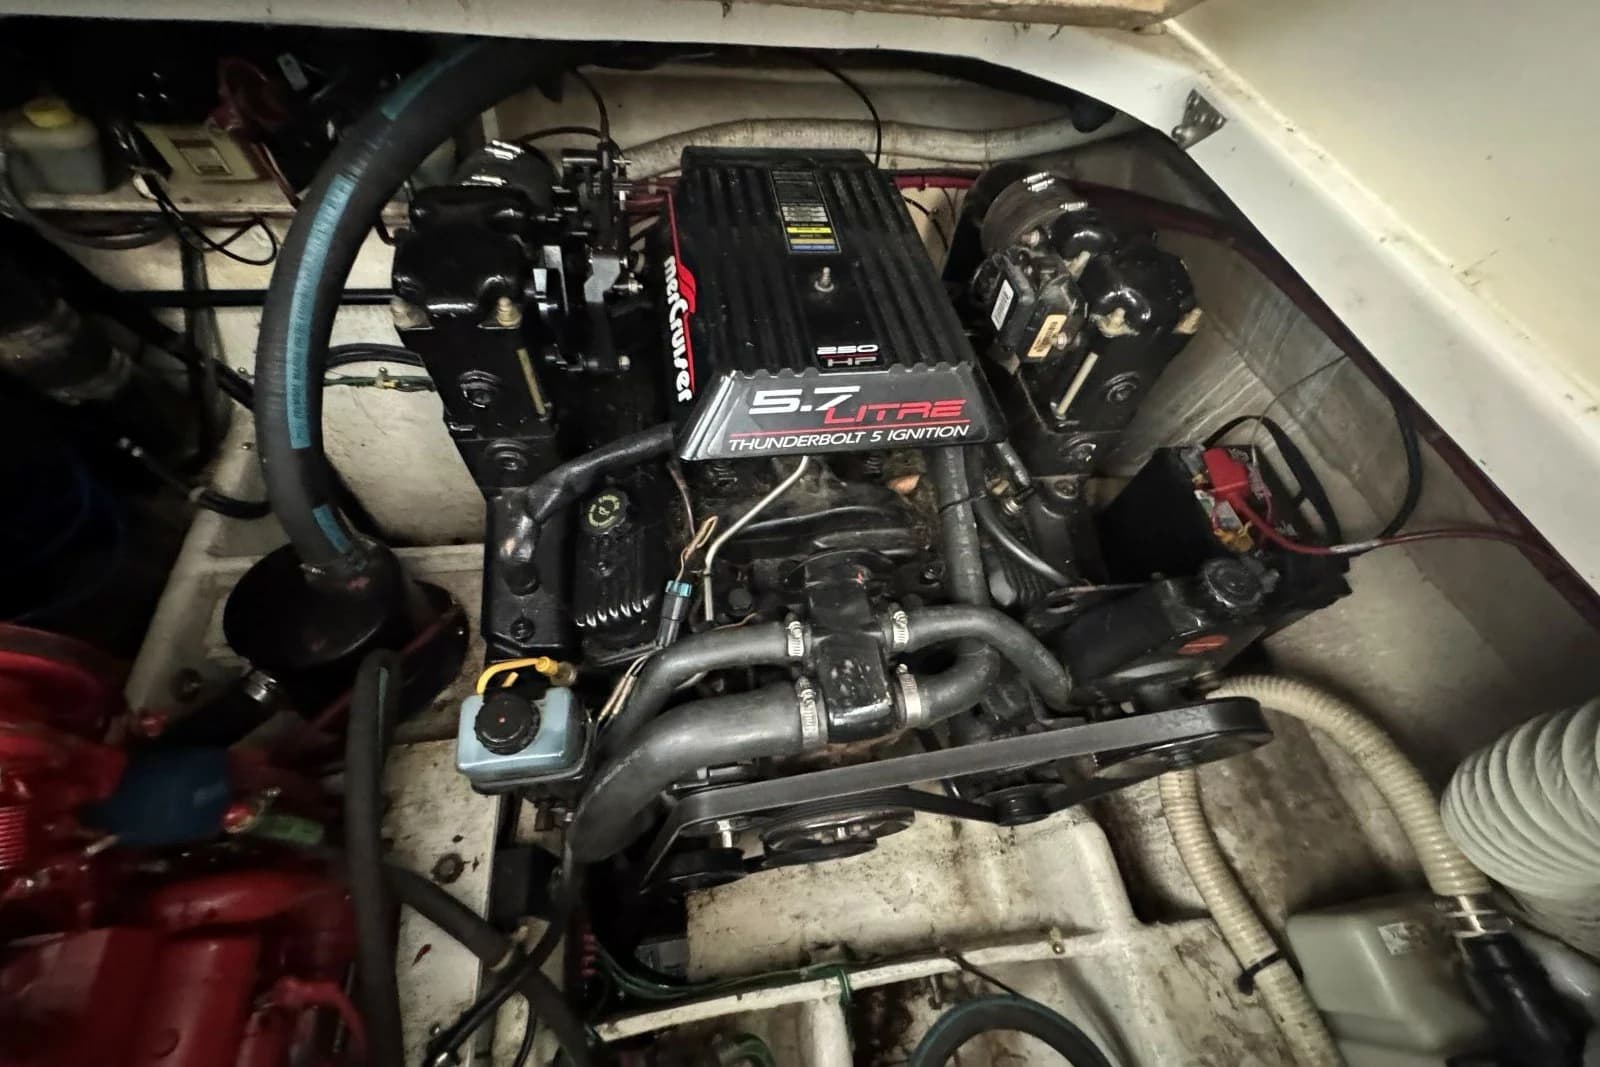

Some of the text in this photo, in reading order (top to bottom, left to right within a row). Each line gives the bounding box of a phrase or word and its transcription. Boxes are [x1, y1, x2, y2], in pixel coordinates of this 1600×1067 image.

[827, 356, 877, 367] HP
[749, 385, 861, 415] 5.7
[824, 400, 967, 424] LITRE
[728, 424, 969, 451] THUNDERBOLT 5 IGNITION
